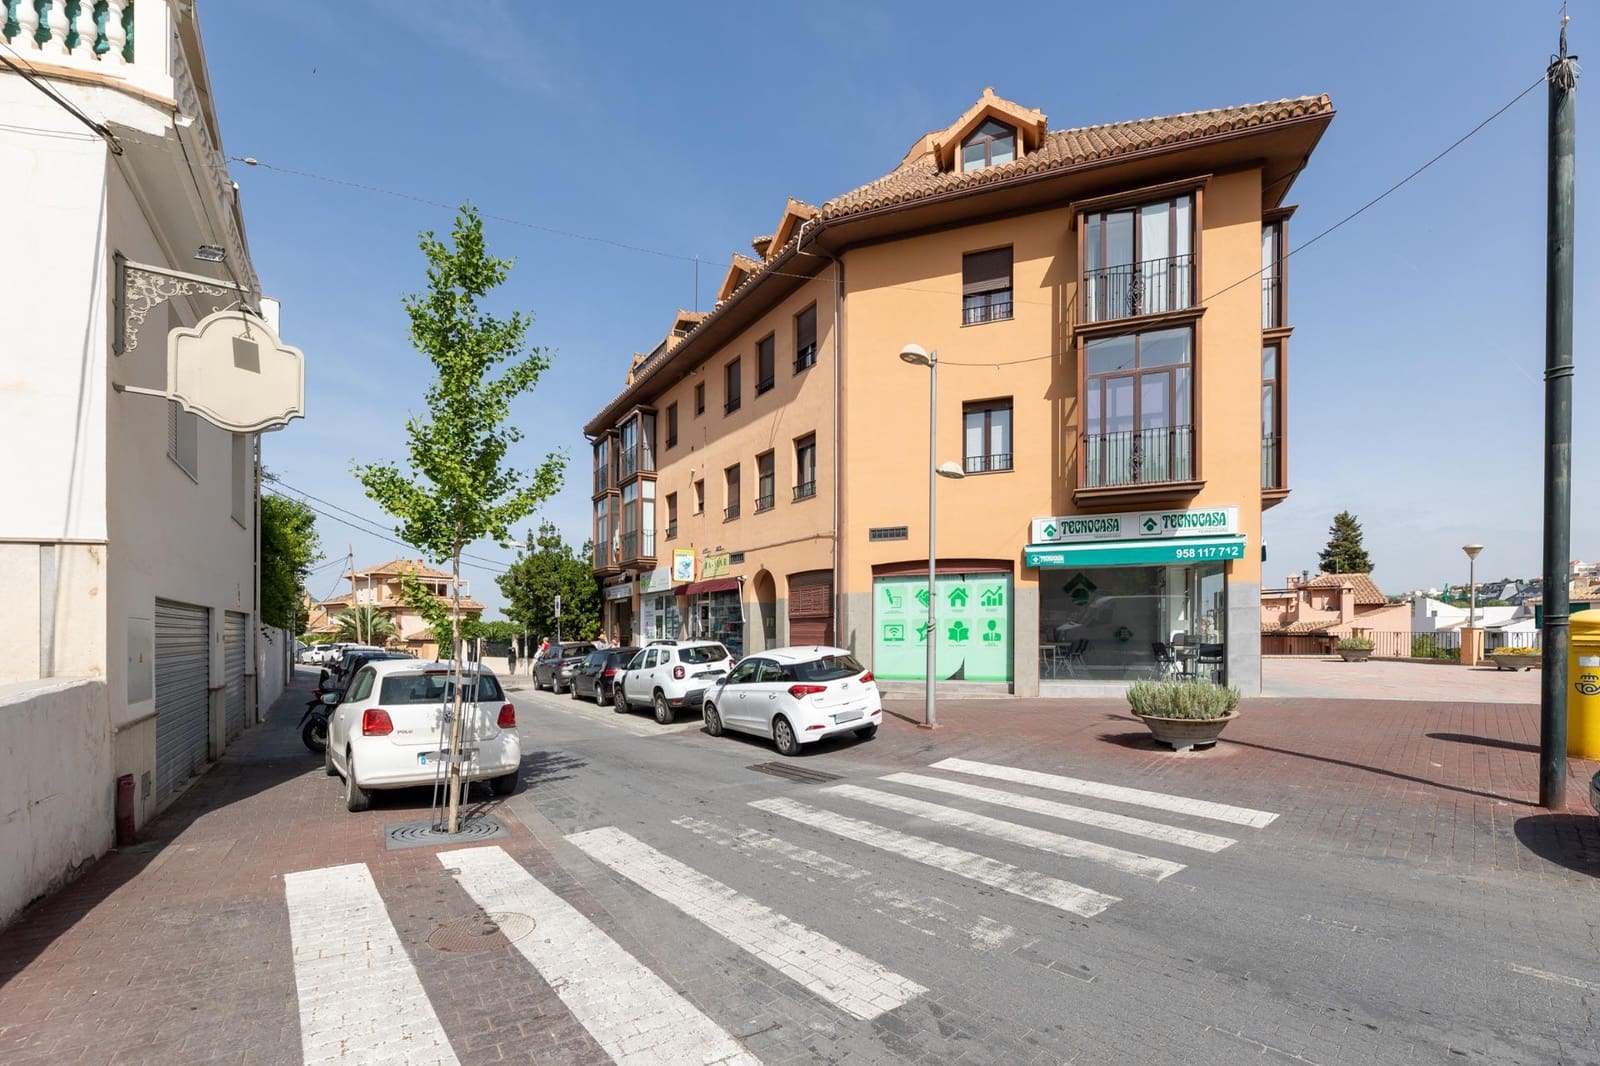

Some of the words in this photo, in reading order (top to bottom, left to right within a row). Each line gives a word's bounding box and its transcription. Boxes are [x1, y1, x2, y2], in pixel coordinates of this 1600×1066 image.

[1061, 518, 1120, 534] TECNOCASA
[1162, 511, 1226, 528] TECNOCASA
[1176, 548, 1195, 558] 958
[1198, 547, 1215, 557] 117
[1218, 546, 1239, 556] 712
